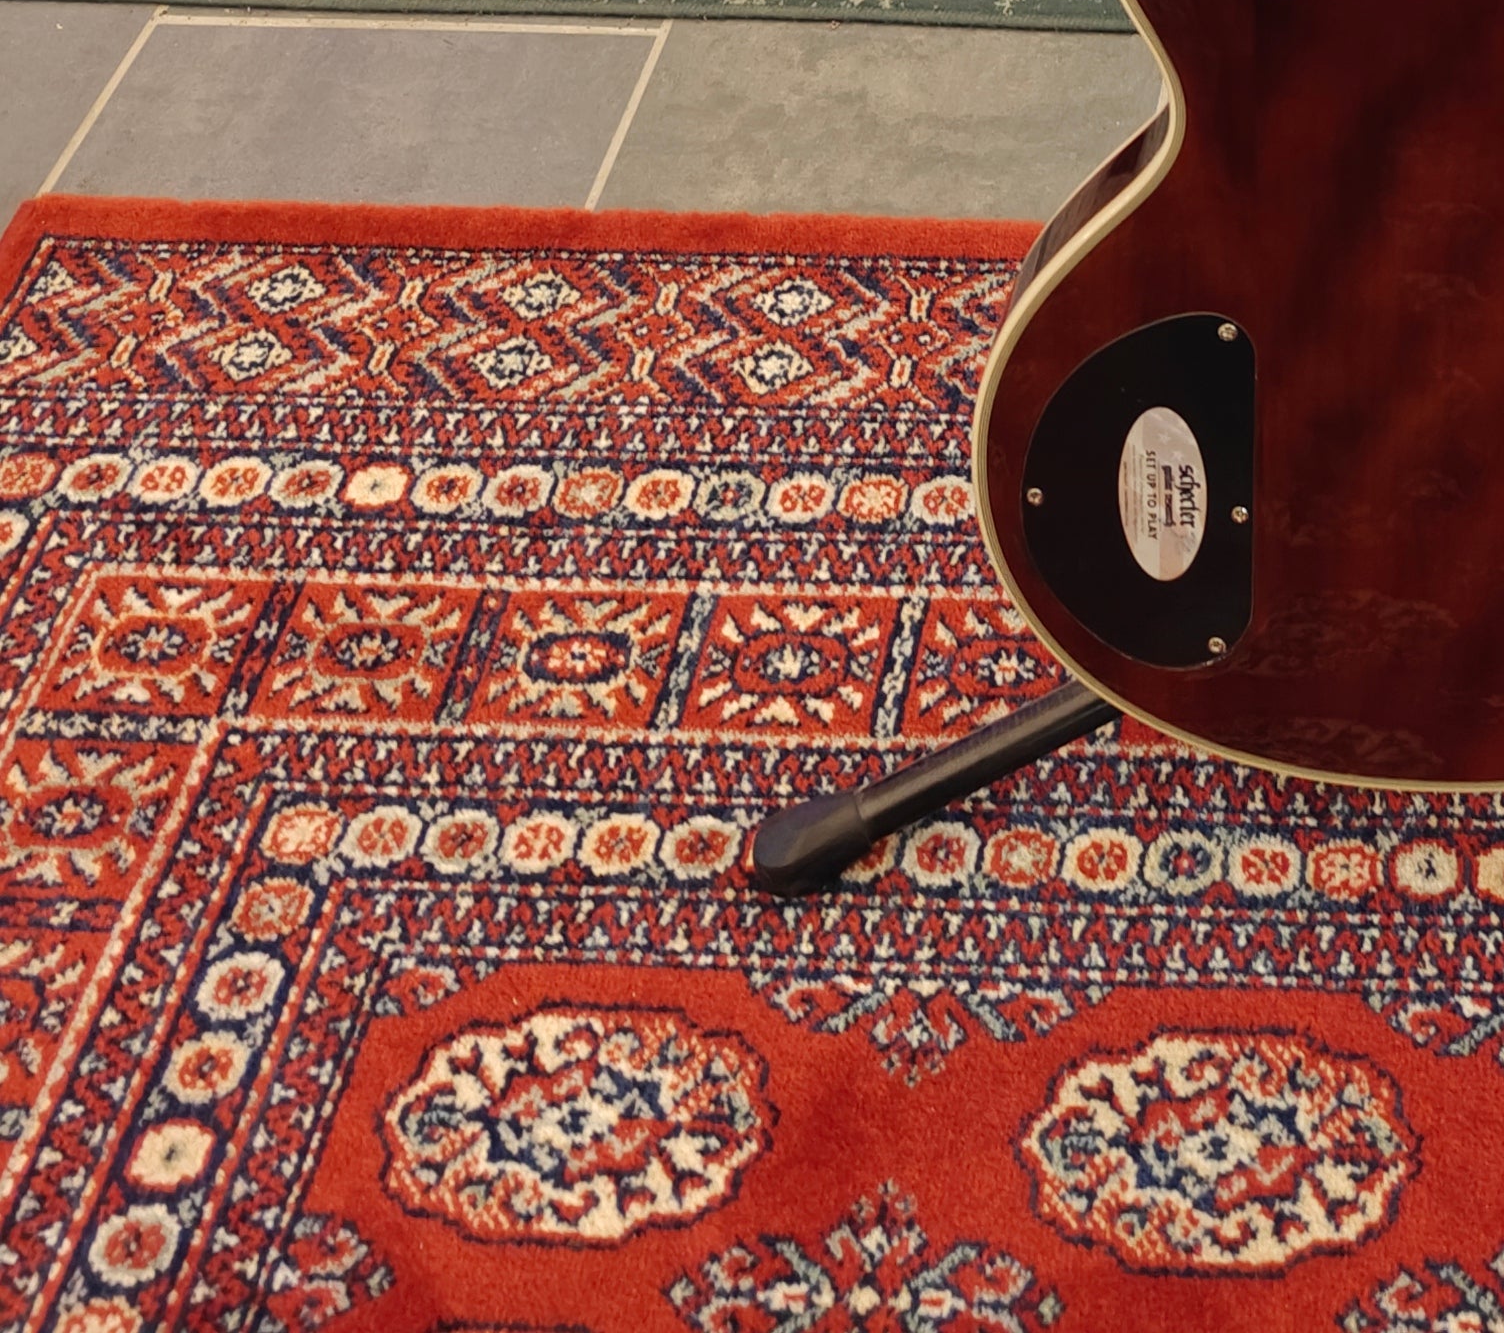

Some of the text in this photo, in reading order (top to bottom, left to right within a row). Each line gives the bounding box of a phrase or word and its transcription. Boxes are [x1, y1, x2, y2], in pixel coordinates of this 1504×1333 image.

[1146, 449, 1158, 540] SET UP TO PLAY
